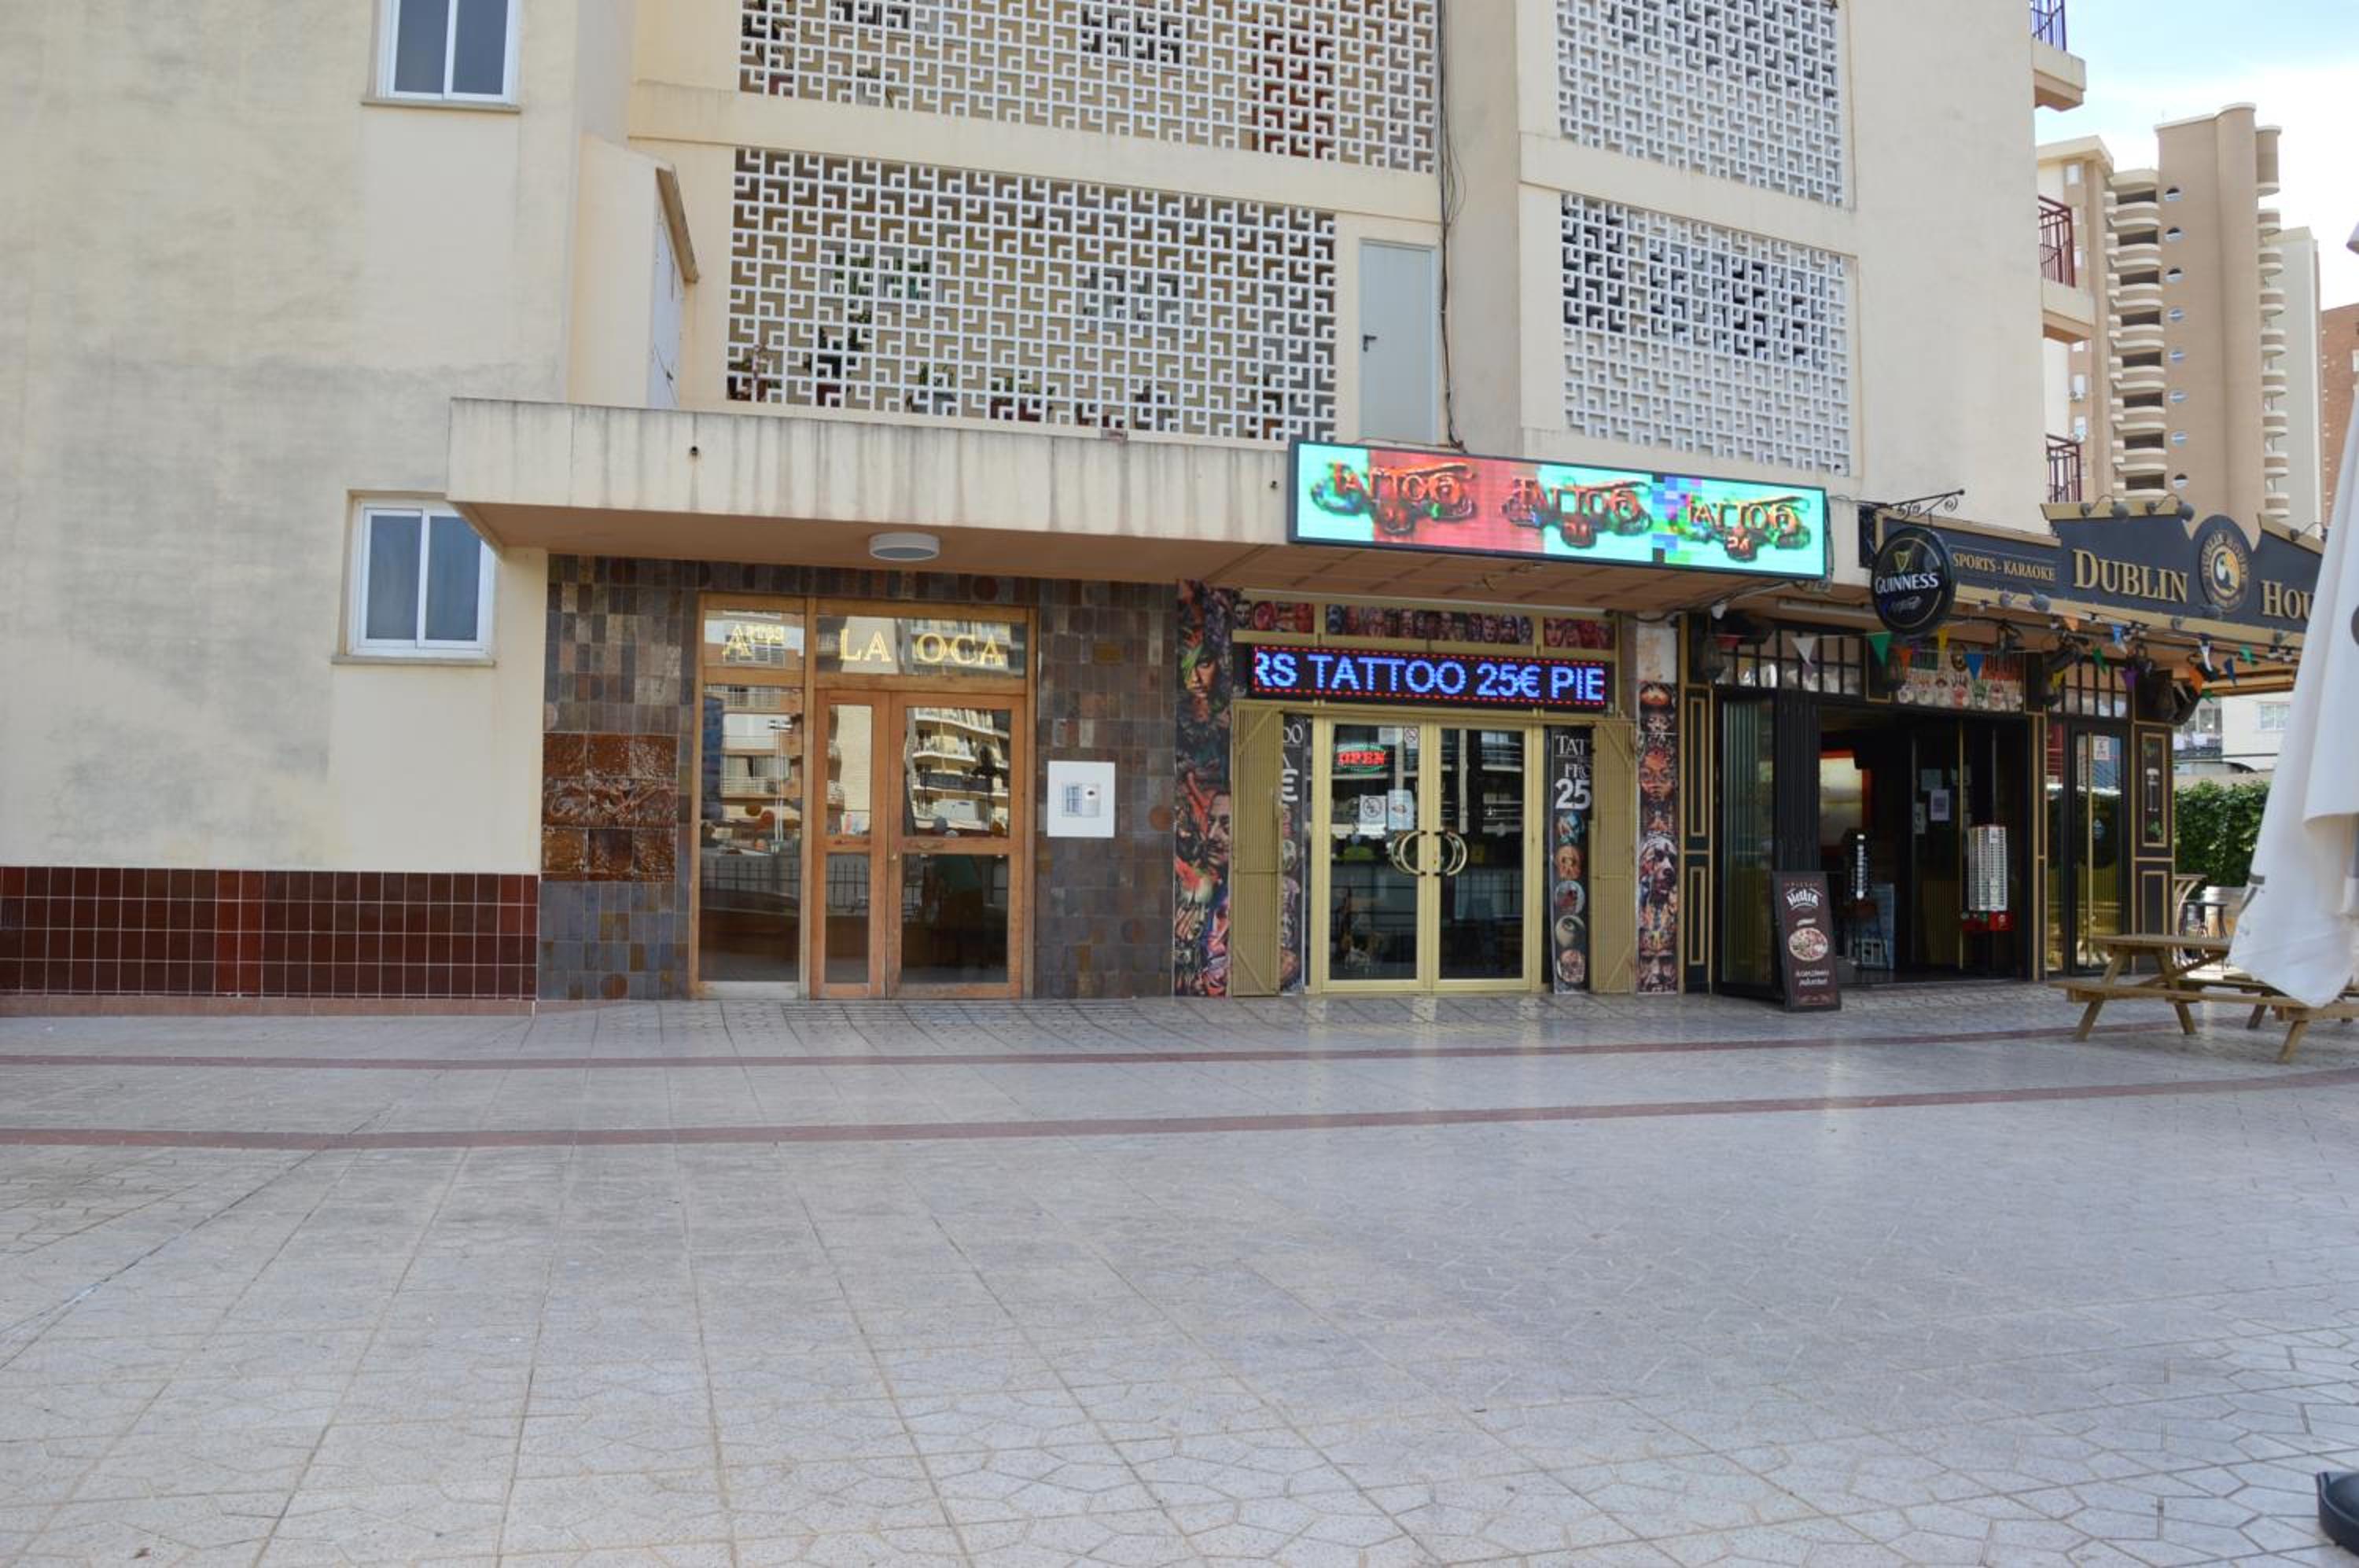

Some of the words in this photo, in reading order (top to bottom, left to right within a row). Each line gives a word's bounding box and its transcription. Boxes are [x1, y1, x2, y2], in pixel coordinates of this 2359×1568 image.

[1952, 552, 1997, 572] SPORTS
[2004, 561, 2057, 581] KARAOKE
[2072, 548, 2189, 604] DUBLIN
[1875, 572, 1939, 594] GUINNESS
[838, 628, 892, 663] LA
[915, 631, 1006, 668] OCA
[1307, 654, 1467, 695] TATTOO
[1476, 662, 1543, 698] 25€
[1550, 665, 1605, 701] PIE
[1338, 750, 1386, 767] OPEN
[1555, 778, 1592, 810] 25
